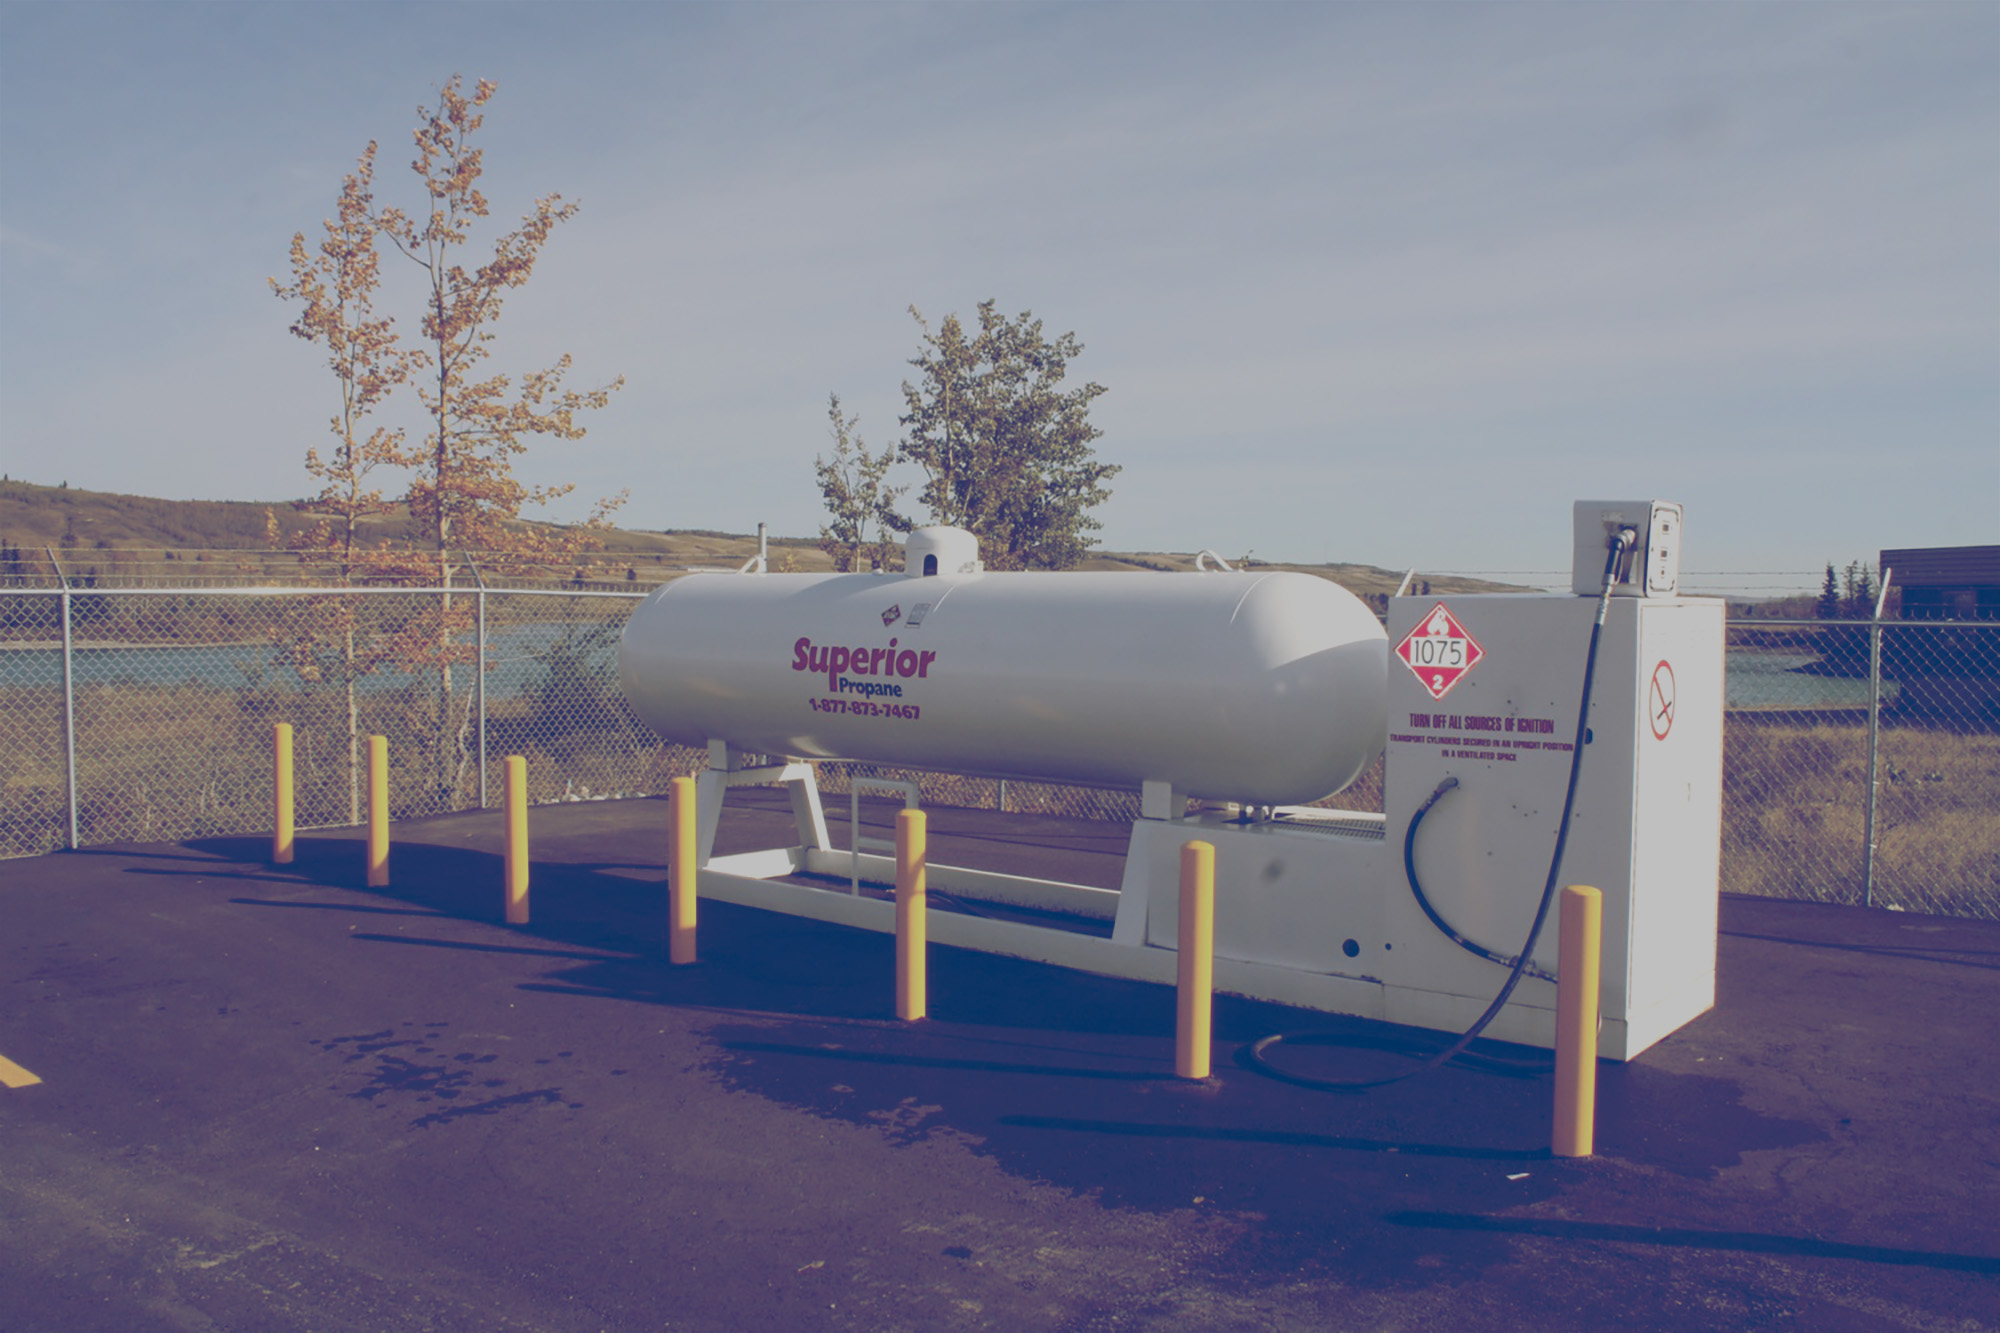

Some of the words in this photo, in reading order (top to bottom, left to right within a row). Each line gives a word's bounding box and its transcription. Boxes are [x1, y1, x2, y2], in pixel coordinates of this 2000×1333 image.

[1414, 640, 1462, 665] 1075
[792, 637, 936, 692] Superior
[839, 677, 903, 699] Propane
[1432, 674, 1444, 690] 2
[809, 698, 920, 720] 1-877-873-7467
[1409, 713, 1430, 728] TURN
[1432, 714, 1447, 729] OFF
[1448, 715, 1462, 730] ALL
[1464, 716, 1502, 731] SOURCES
[1505, 717, 1515, 732] OF
[1517, 718, 1554, 734] IGNITION
[1390, 733, 1425, 743] TRANSPORT
[1426, 735, 1461, 745] CYLINDERS
[1463, 737, 1491, 747] SECURED
[1492, 739, 1500, 748] IN
[1502, 739, 1511, 748] AN
[1513, 740, 1540, 750] UPRIGHT
[1542, 741, 1573, 752] POSITION
[1441, 749, 1449, 758] IN
[1451, 749, 1455, 758] A
[1457, 750, 1495, 760] VENTILATED
[1497, 752, 1516, 762] SPACE
